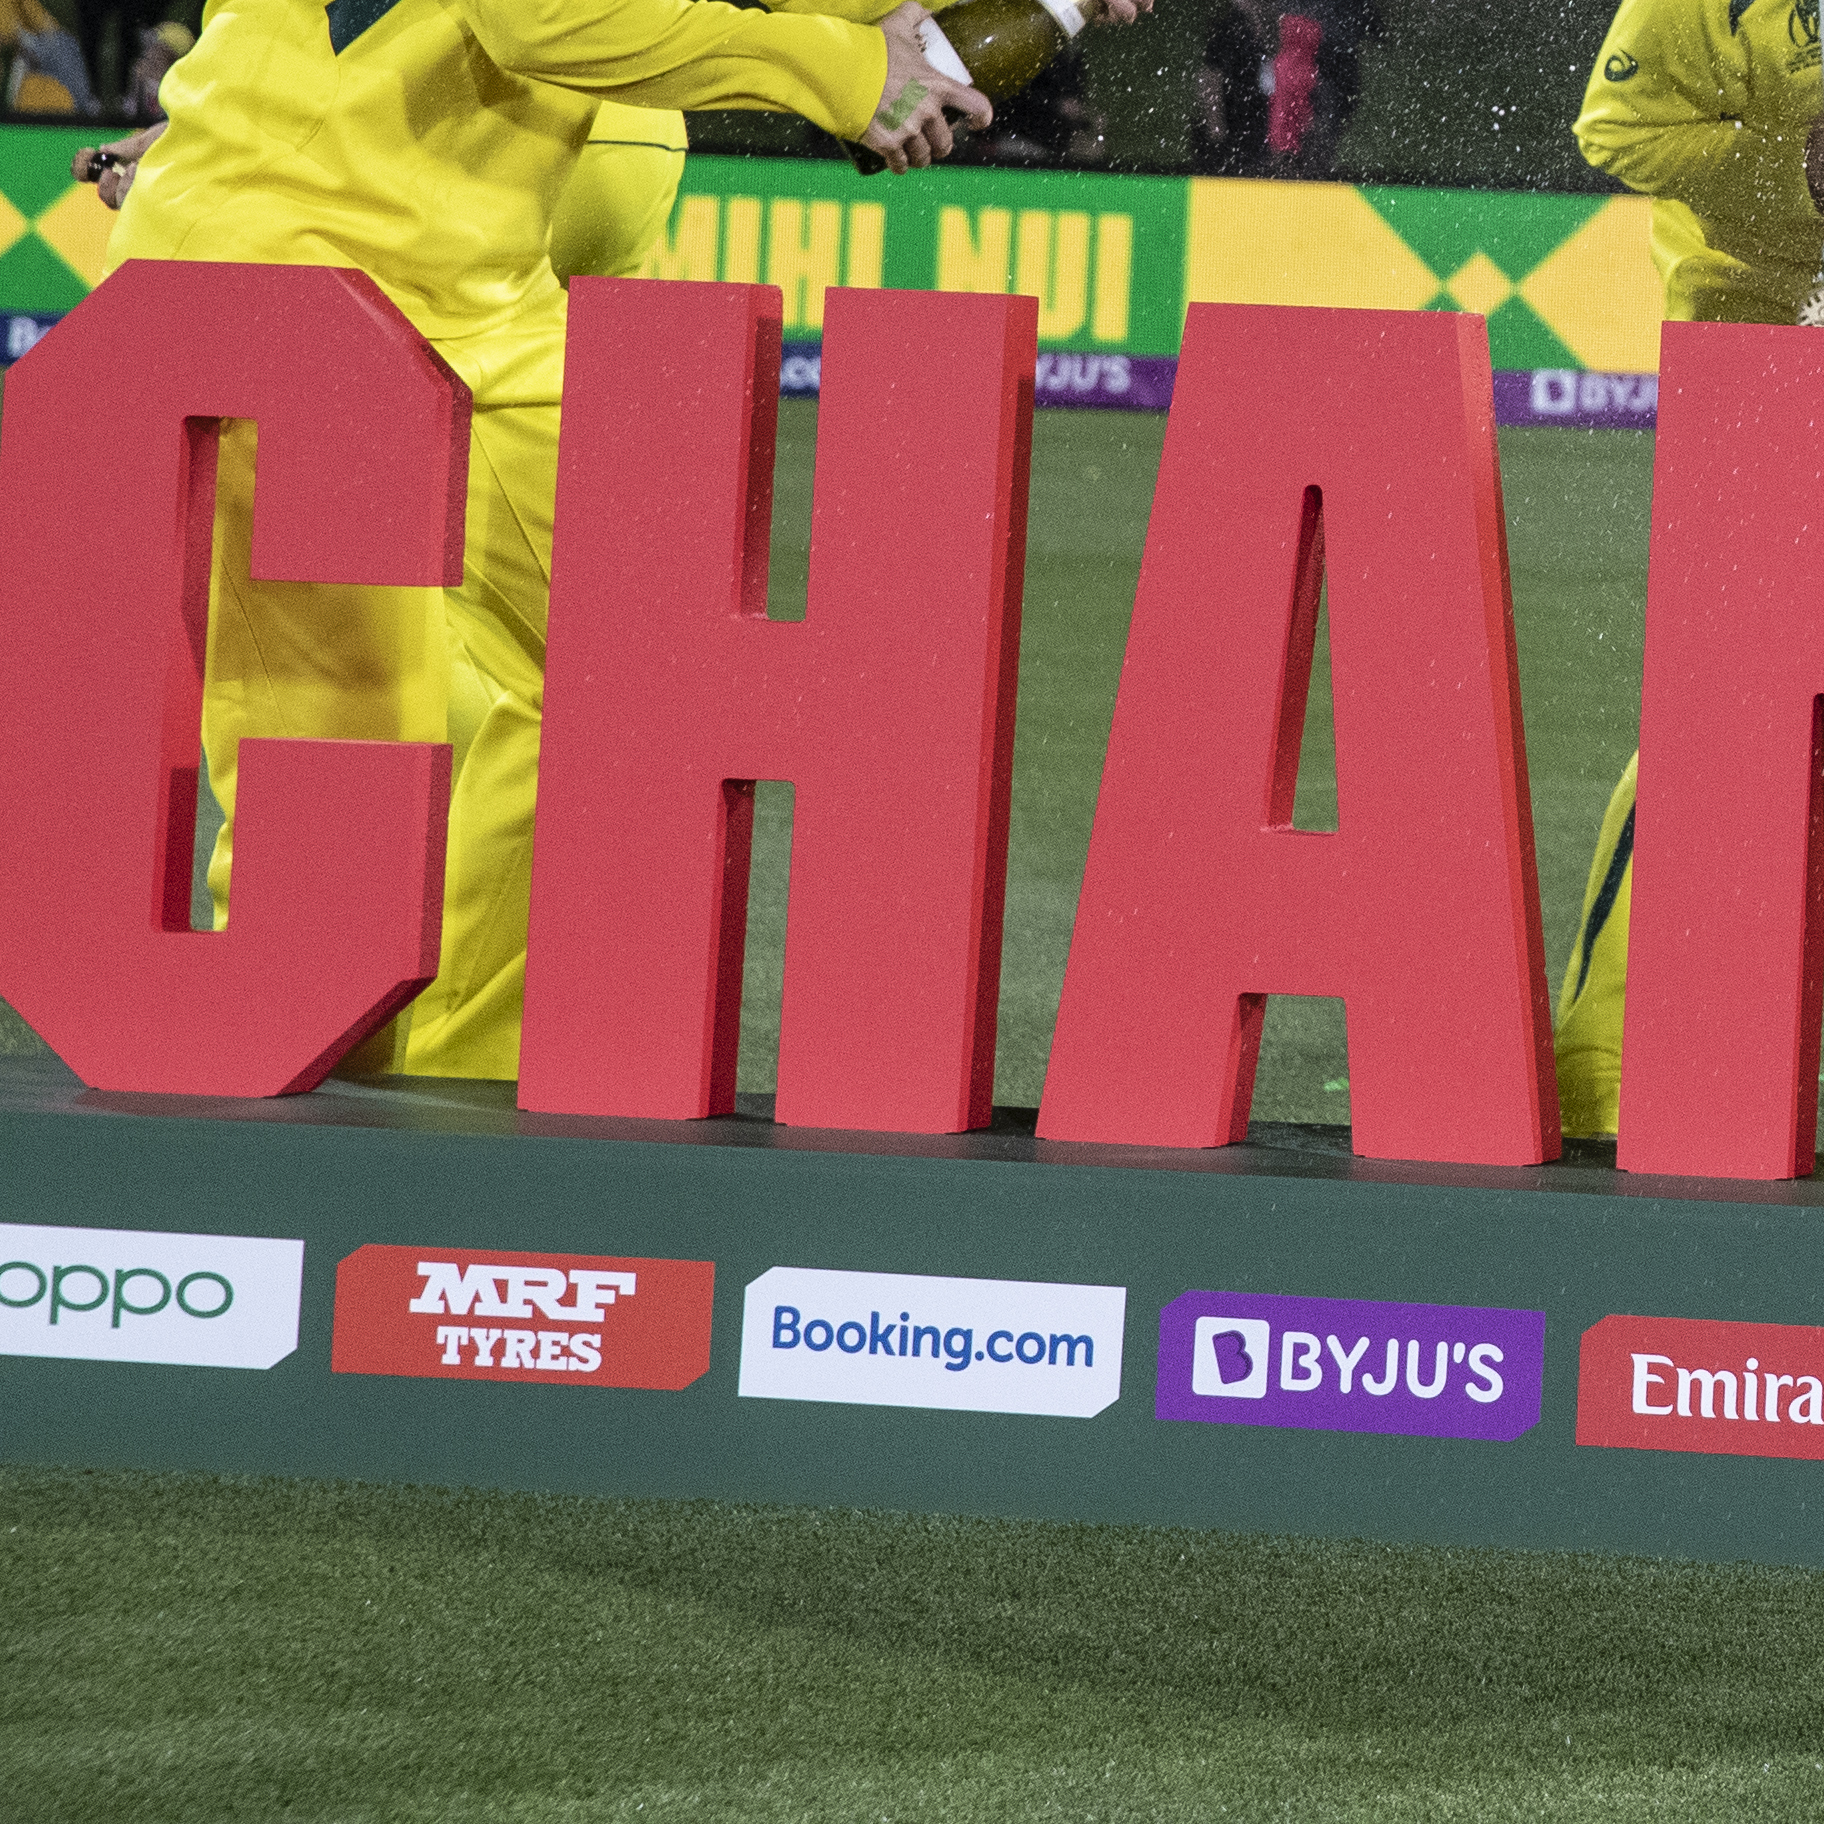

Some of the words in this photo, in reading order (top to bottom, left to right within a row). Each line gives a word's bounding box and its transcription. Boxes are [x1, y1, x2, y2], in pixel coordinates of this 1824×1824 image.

[938, 204, 1134, 344] NUI
[0, 1260, 234, 1329] oppo
[409, 1260, 637, 1323] MRF
[435, 1325, 603, 1373] TYRES
[771, 1304, 1096, 1373] Booking.com
[1281, 1330, 1505, 1404] BYJU'S
